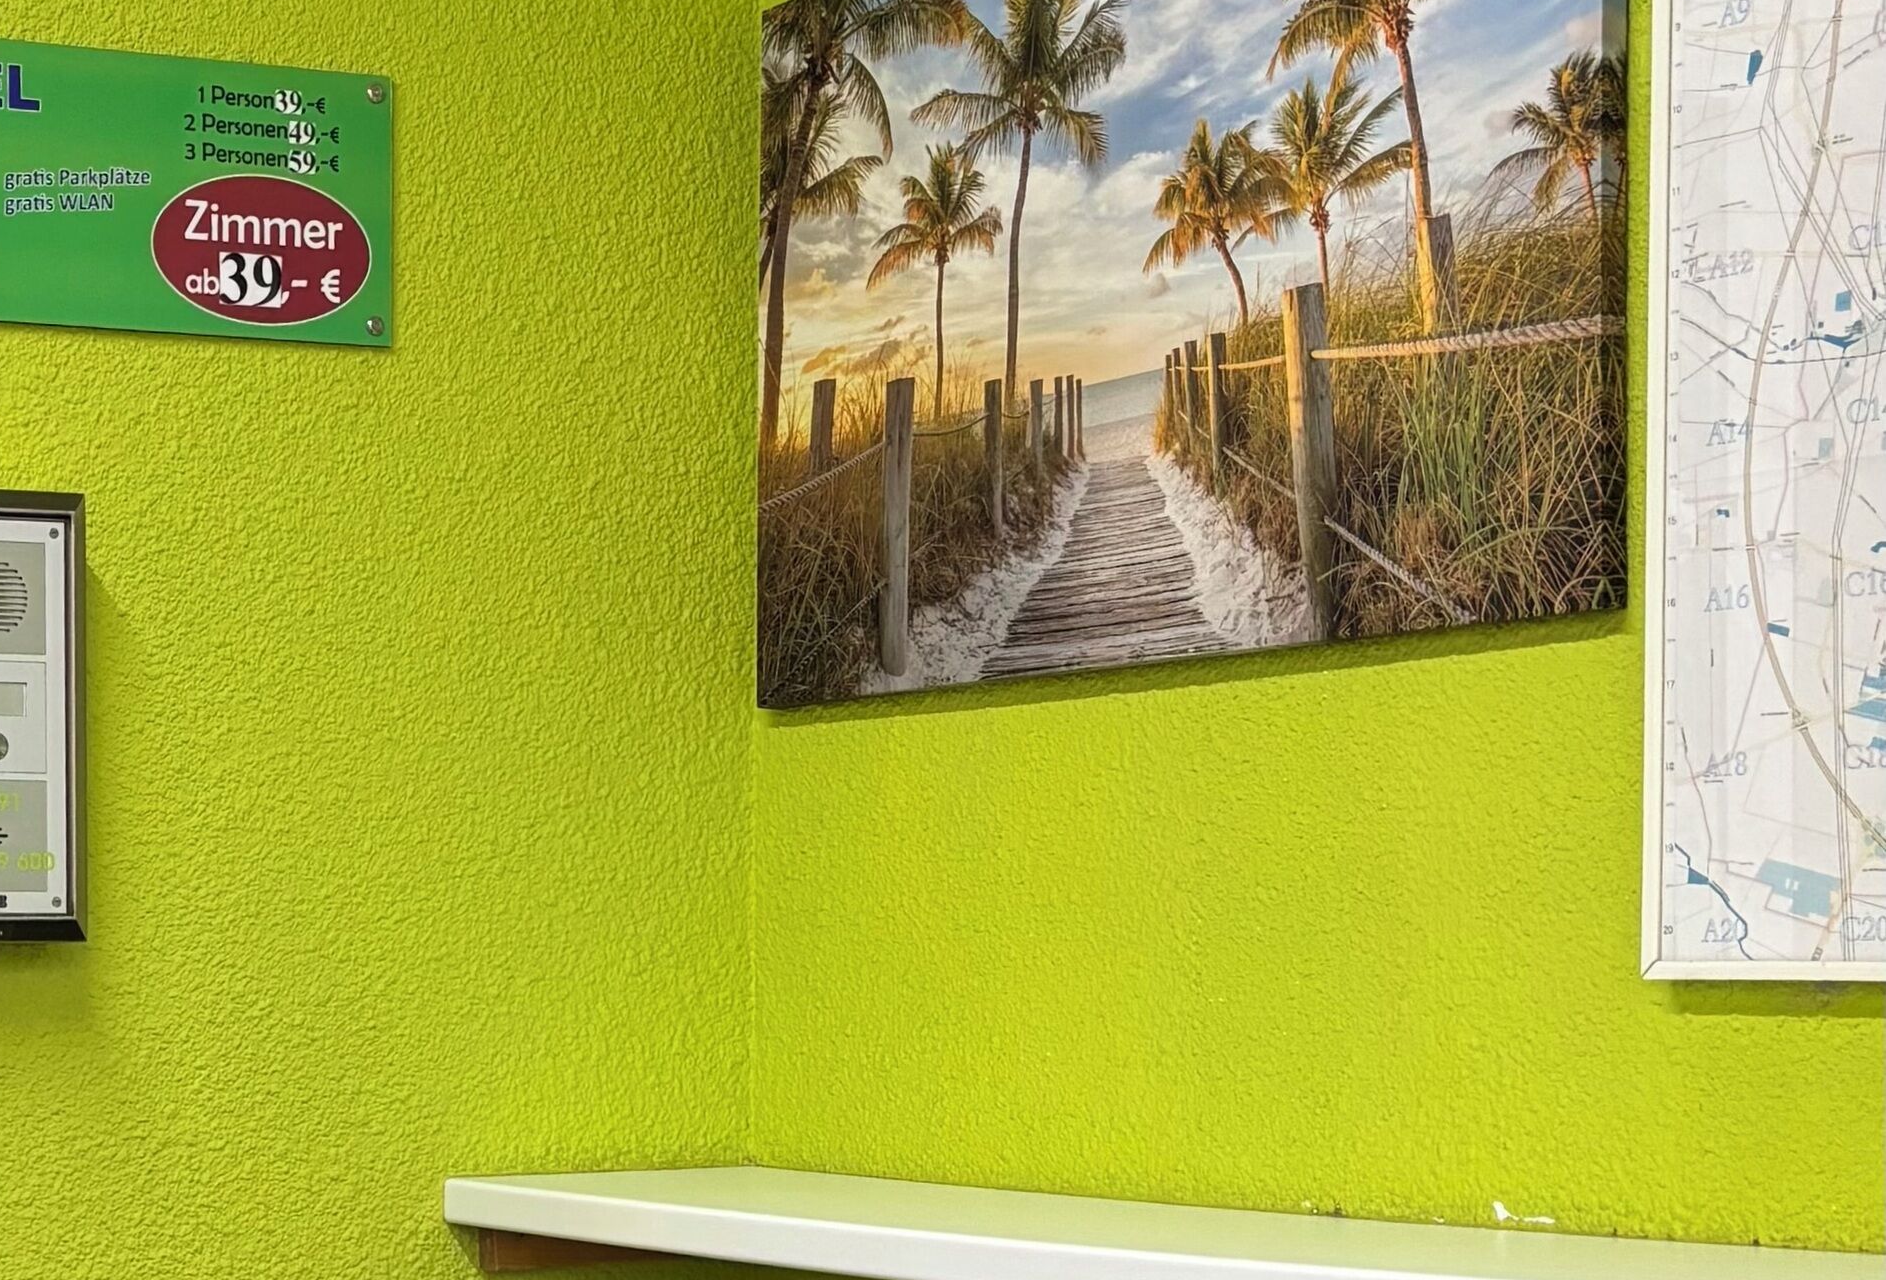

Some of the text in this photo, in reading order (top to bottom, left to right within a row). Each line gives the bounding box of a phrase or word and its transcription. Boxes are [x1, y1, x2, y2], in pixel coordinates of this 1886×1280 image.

[198, 86, 205, 104] 1
[1673, 104, 1682, 114] 10
[184, 114, 196, 131] 2
[185, 143, 196, 161] 3
[4, 167, 152, 191] gratis Parkplätze
[4, 193, 114, 216] gratis WLAN
[184, 199, 344, 251] Zimmer
[1846, 395, 1886, 424] C1
[1704, 584, 1749, 612] A16
[1704, 751, 1748, 777] A18
